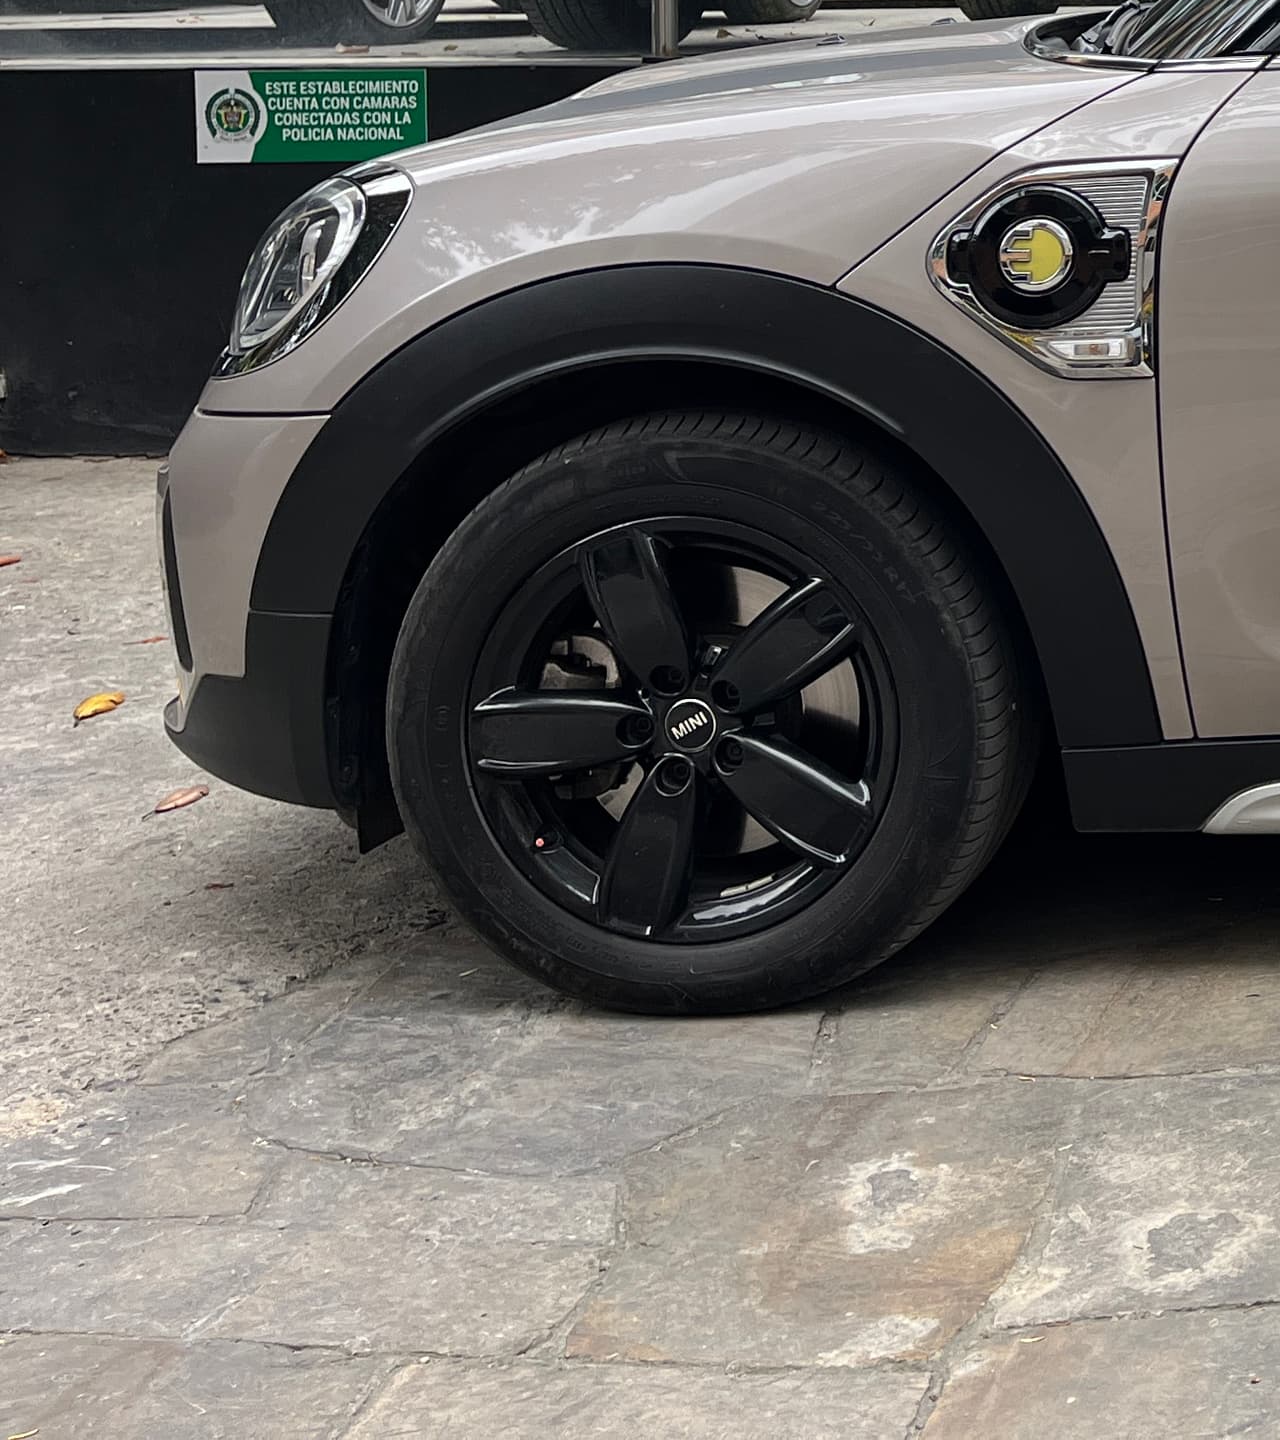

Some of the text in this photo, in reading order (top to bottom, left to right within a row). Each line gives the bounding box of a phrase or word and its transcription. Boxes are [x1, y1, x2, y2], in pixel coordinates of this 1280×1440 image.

[265, 80, 419, 95] ESTE ESTABLECIMIENTO
[267, 95, 417, 110] CUENTA CON CAMARAS
[274, 111, 411, 126] CONECTADAS CON LA
[282, 127, 404, 141] POLICIA NACIONAL
[671, 711, 708, 740] MINI
